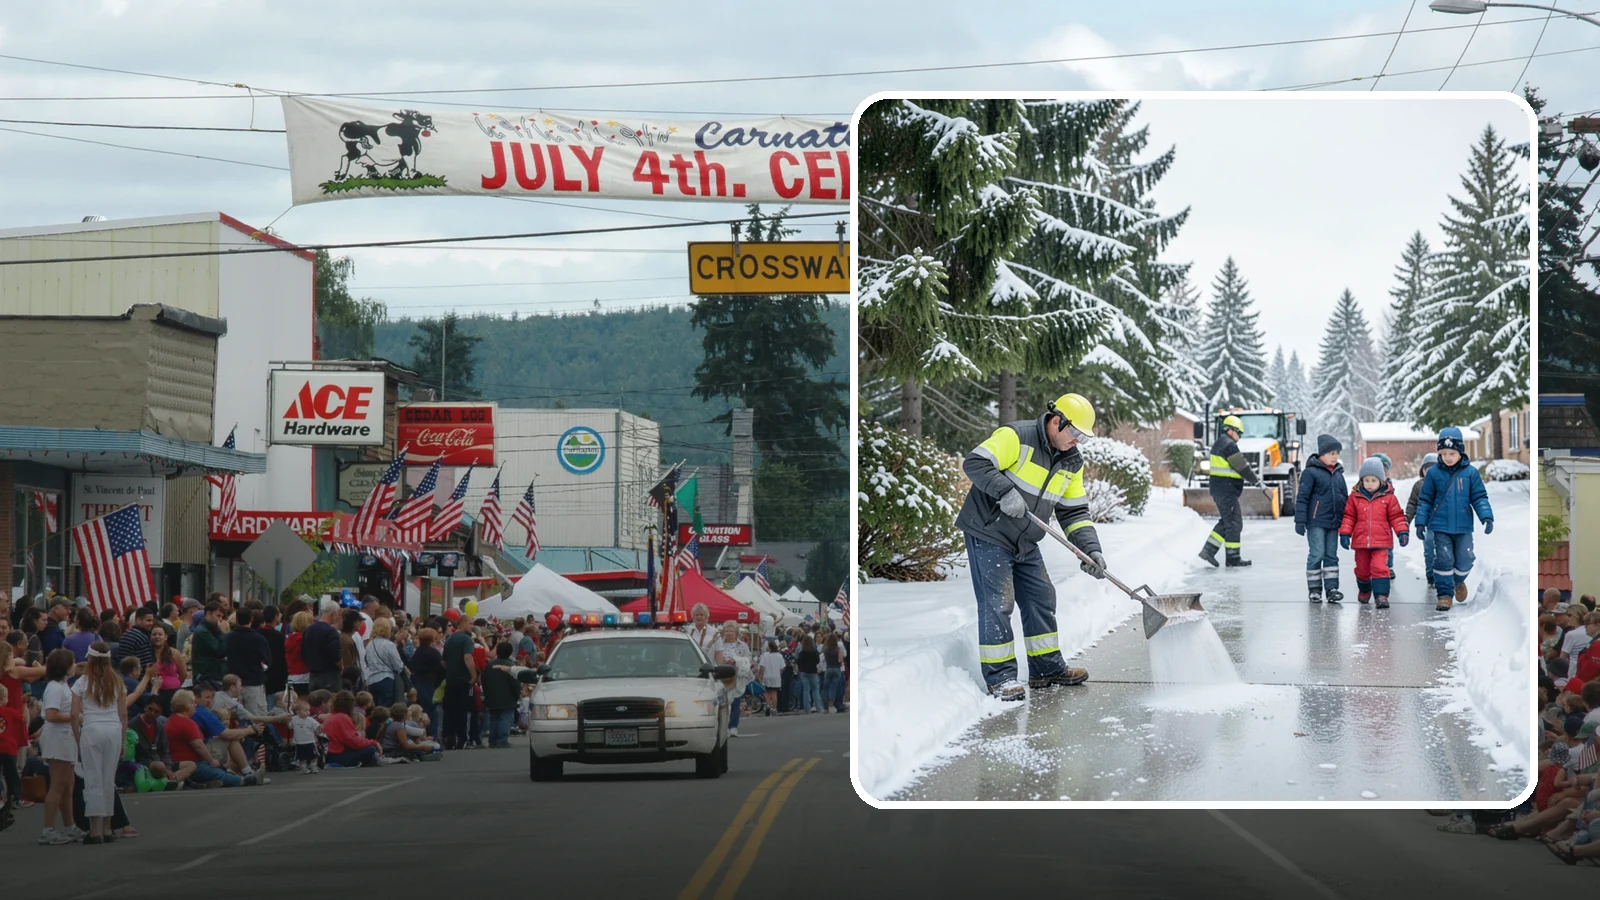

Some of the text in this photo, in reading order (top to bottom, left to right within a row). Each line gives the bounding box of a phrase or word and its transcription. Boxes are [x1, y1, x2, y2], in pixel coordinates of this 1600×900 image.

[481, 141, 605, 192] JULY
[632, 150, 746, 198] 4th.
[697, 254, 850, 280] CROSSWA
[283, 380, 373, 420] ACE
[405, 409, 452, 422] CEDAR
[284, 421, 371, 437] Hardware
[416, 428, 477, 447] Coca-Cola
[353, 466, 386, 480] Simpl
[95, 485, 124, 495] Vincent
[126, 486, 136, 495] de
[137, 486, 155, 495] Paul
[688, 526, 741, 535] CRNATION
[699, 535, 730, 543] GLASS
